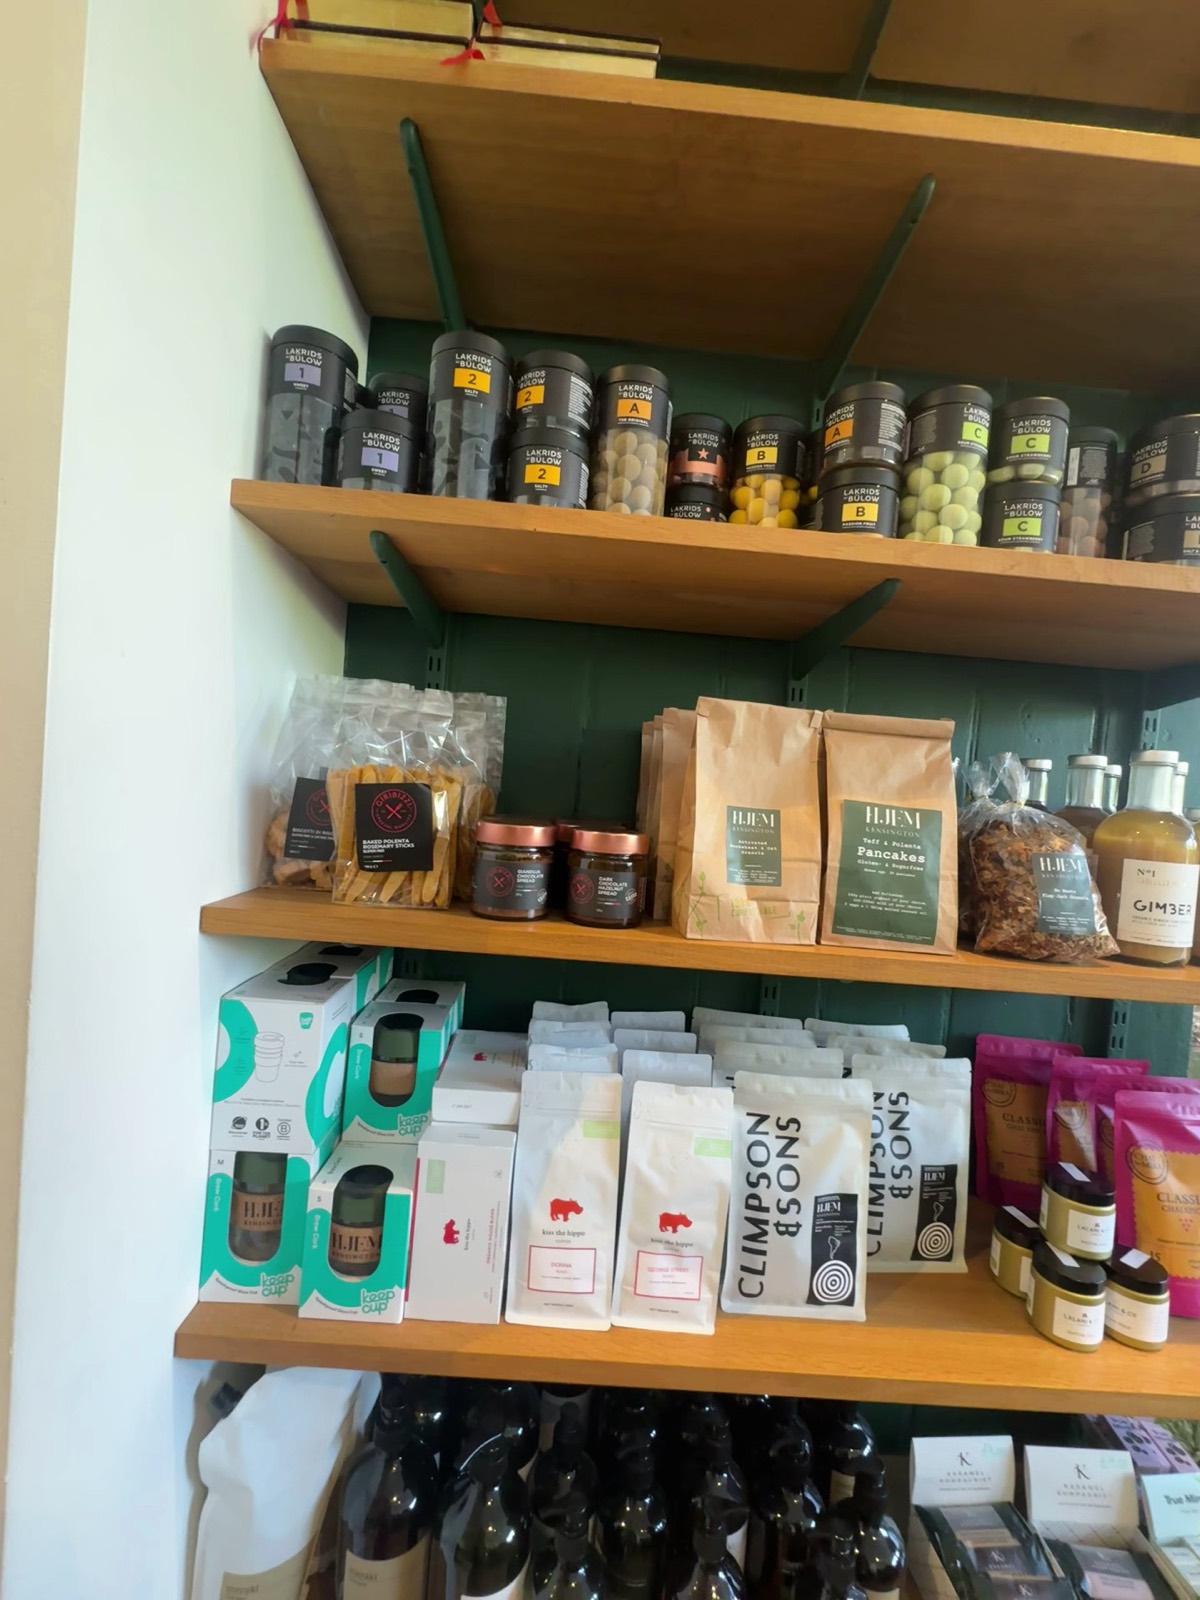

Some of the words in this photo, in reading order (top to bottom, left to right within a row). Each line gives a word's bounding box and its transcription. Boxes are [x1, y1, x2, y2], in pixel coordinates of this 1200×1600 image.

[286, 348, 322, 359] LAKRIDS
[455, 353, 492, 366] LAKRIDS
[290, 355, 322, 366] BÜLOW
[299, 367, 304, 379] 1
[460, 360, 492, 374] BÜLOW
[468, 374, 477, 385] 2
[618, 384, 653, 394] LAKRIDS
[378, 391, 410, 400] LAKRIDS
[524, 391, 532, 403] 2
[622, 391, 653, 401] BÜLOW
[629, 402, 640, 414] A
[1012, 419, 1051, 428] LAKRIDS
[362, 431, 400, 445] LAKRIDS
[688, 432, 719, 442] LAKRIDS
[747, 434, 779, 443] LAKRIDS
[832, 427, 841, 439] A
[974, 428, 982, 438] C
[367, 439, 400, 452] BÜLOW
[1026, 437, 1036, 449] C
[377, 452, 383, 464] 1
[526, 449, 562, 459] LAKRIDS
[757, 450, 766, 461] B
[530, 456, 562, 466] BÜLOW
[537, 468, 547, 480] 2
[1141, 463, 1152, 474] D
[843, 488, 880, 496] LAKRIDS
[856, 506, 865, 517] B
[1004, 502, 1043, 511] LAKRIDS
[1017, 521, 1028, 532] C
[865, 826, 921, 838] KENSINGTON
[863, 837, 880, 845] Teff
[892, 841, 921, 850] Polenta
[857, 846, 926, 863] Pancakes
[888, 1091, 912, 1180] SONS
[775, 1116, 802, 1215] SONS
[738, 1112, 771, 1298] CLIMPSON
[567, 1229, 585, 1237] hippo
[312, 1231, 320, 1250] Cork
[261, 1272, 295, 1287] keep
[261, 1284, 288, 1298] cup
[362, 1289, 395, 1304] keep
[362, 1302, 388, 1315] cup
